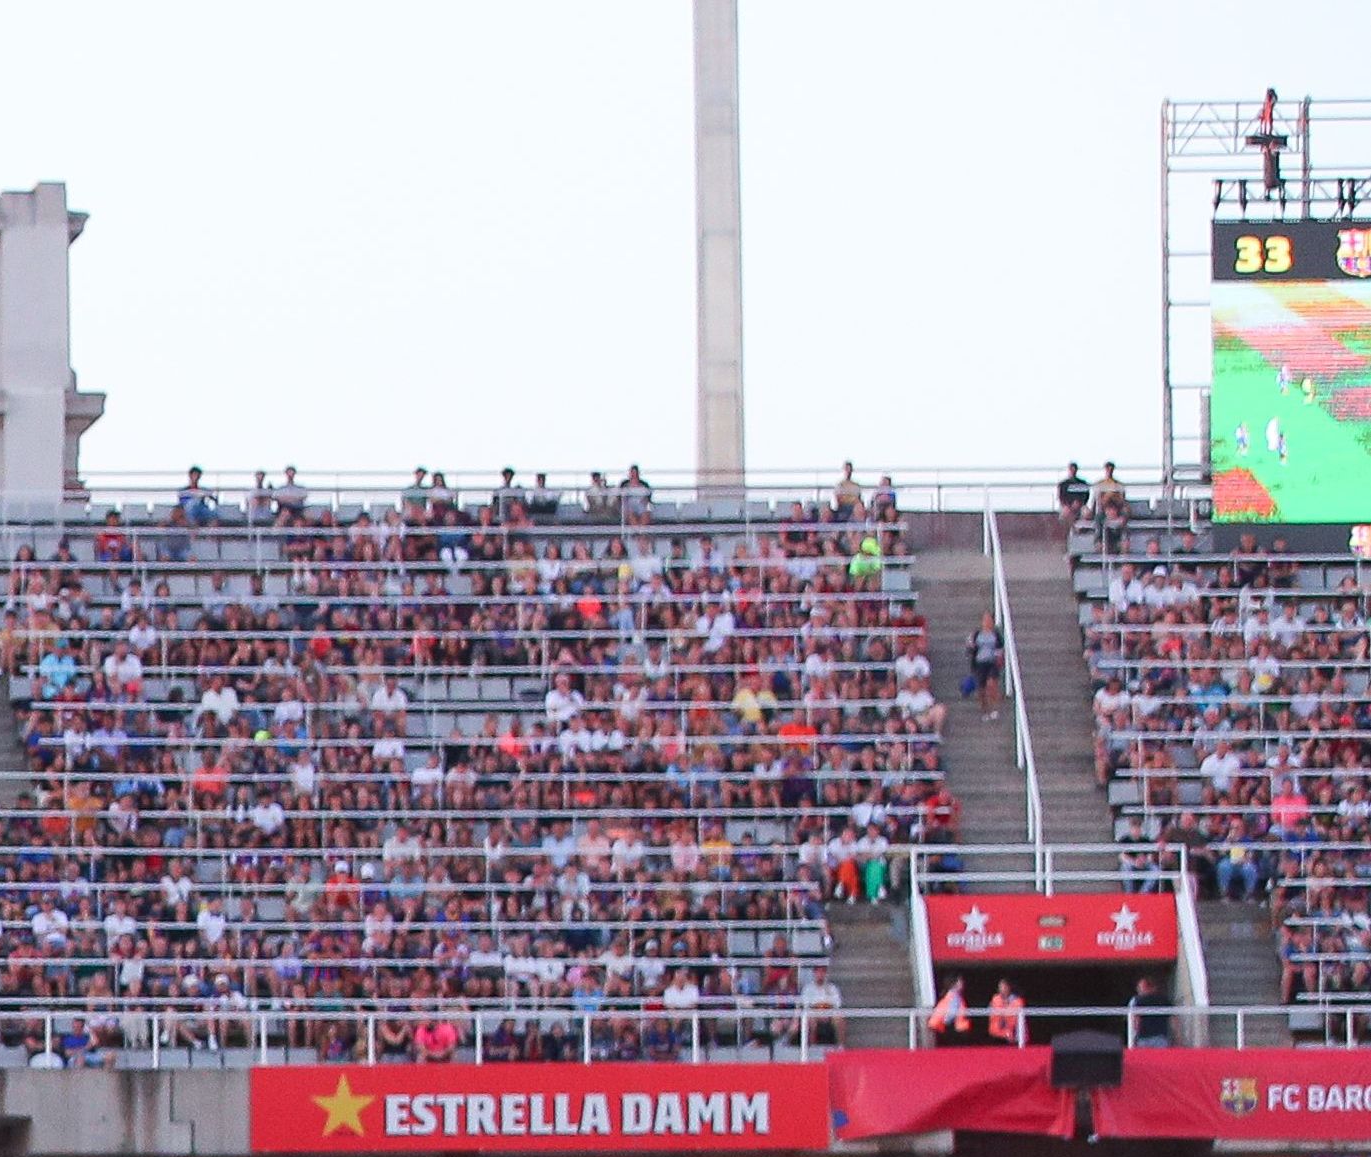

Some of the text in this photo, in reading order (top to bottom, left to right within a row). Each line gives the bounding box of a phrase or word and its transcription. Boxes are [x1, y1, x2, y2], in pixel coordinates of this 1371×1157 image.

[1235, 235, 1293, 273] 33
[384, 1092, 771, 1136] ESTRELLA DAMM
[1268, 1083, 1302, 1113] FC
